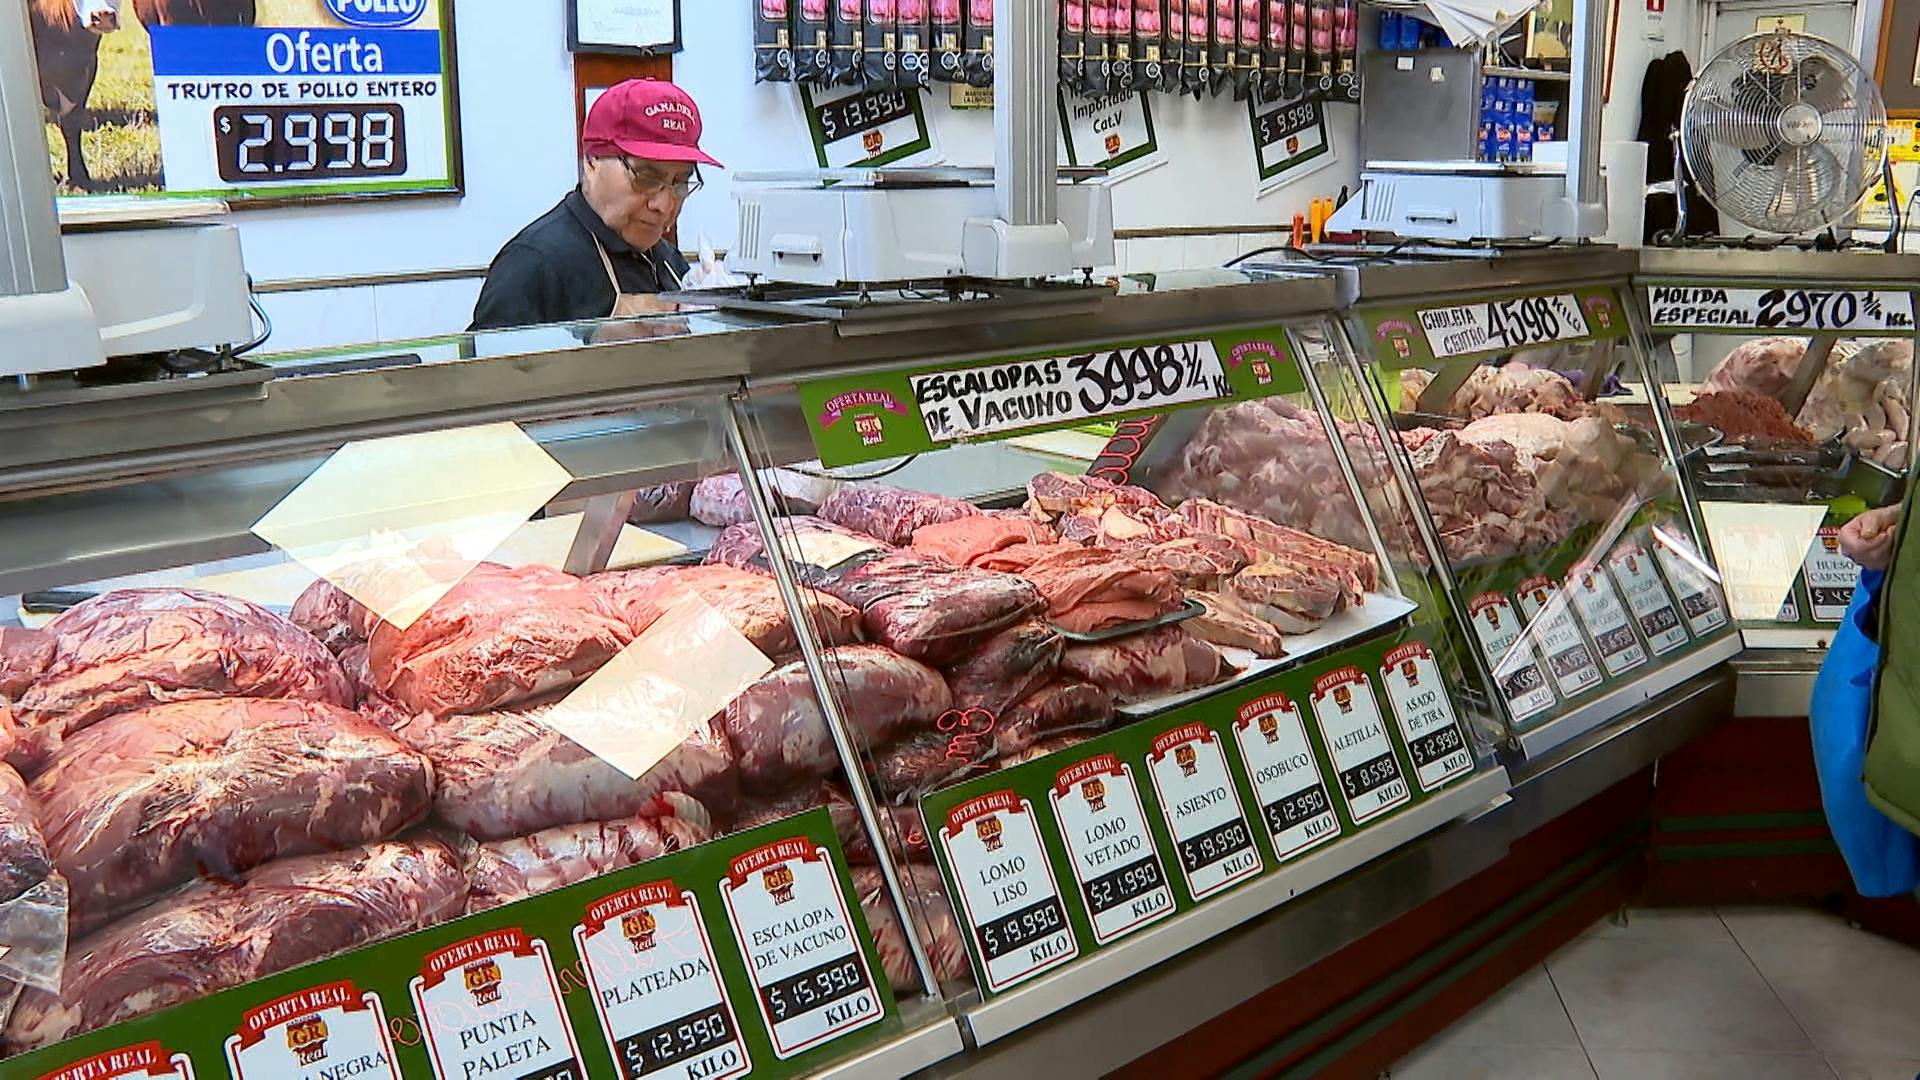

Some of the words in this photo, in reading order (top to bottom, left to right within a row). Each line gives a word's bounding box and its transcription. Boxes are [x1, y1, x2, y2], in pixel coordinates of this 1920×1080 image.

[266, 31, 383, 73] Oferta
[168, 83, 251, 99] TRUTRO
[262, 83, 289, 98] DE
[298, 82, 357, 98] POLLO
[367, 81, 436, 97] ENTERO
[663, 118, 687, 132] REAL
[239, 112, 394, 173] 2.998
[1652, 287, 1729, 306] MOLIDA
[1653, 307, 1755, 326] ESPECIAL
[1755, 287, 1857, 330] 2970
[1421, 307, 1477, 331] CHULETA
[1488, 296, 1560, 348] 4598
[1552, 296, 1582, 333] KILO
[1443, 325, 1488, 354] CENTRO
[915, 358, 1063, 404] ESCALOPAS
[1066, 345, 1184, 413] 3998
[924, 406, 954, 436] DE
[958, 391, 1073, 430] VACUNO
[1816, 560, 1855, 570] HUESO
[1406, 690, 1436, 713] ASADO
[1155, 730, 1186, 752] OFERTA
[1184, 724, 1205, 741] REAL
[1333, 722, 1381, 753] ALETILLA
[1408, 716, 1423, 731] DE
[1059, 761, 1092, 787] OFERTA
[1091, 757, 1115, 772] REAL
[1256, 752, 1310, 785] OSOBUCO
[1442, 753, 1467, 773] KILO
[951, 799, 989, 824] OFERTA
[987, 793, 1014, 809] REAL
[1175, 786, 1227, 820] ASIENTO
[1377, 782, 1403, 805] KILO
[1085, 817, 1126, 845] LOMO
[1304, 815, 1333, 839] KILO
[735, 849, 778, 875] OFERTA
[777, 842, 808, 858] REAL
[1084, 835, 1142, 868] VETADO
[1222, 852, 1254, 877] KILO
[979, 855, 1026, 886] LOMO
[590, 892, 640, 922] OFERTA
[639, 885, 673, 901] REAL
[992, 880, 1028, 907] LISO
[1131, 891, 1167, 919] KILO
[752, 906, 836, 947] ESCALOPA
[430, 941, 485, 973] OFERTA
[484, 933, 521, 951] REAL
[754, 952, 779, 971] DE
[779, 924, 847, 961] VACUNO
[1029, 935, 1068, 964] KILO
[601, 957, 711, 1009] PLATEADA
[249, 993, 308, 1031] OFERTA
[308, 986, 352, 1008] REAL
[824, 995, 871, 1027] KILO
[460, 1009, 538, 1050] PUNTA
[108, 1049, 158, 1071] REAL
[320, 1050, 388, 1080] NEGRA
[462, 1035, 552, 1080] PALETA
[687, 1049, 738, 1080] KILO
